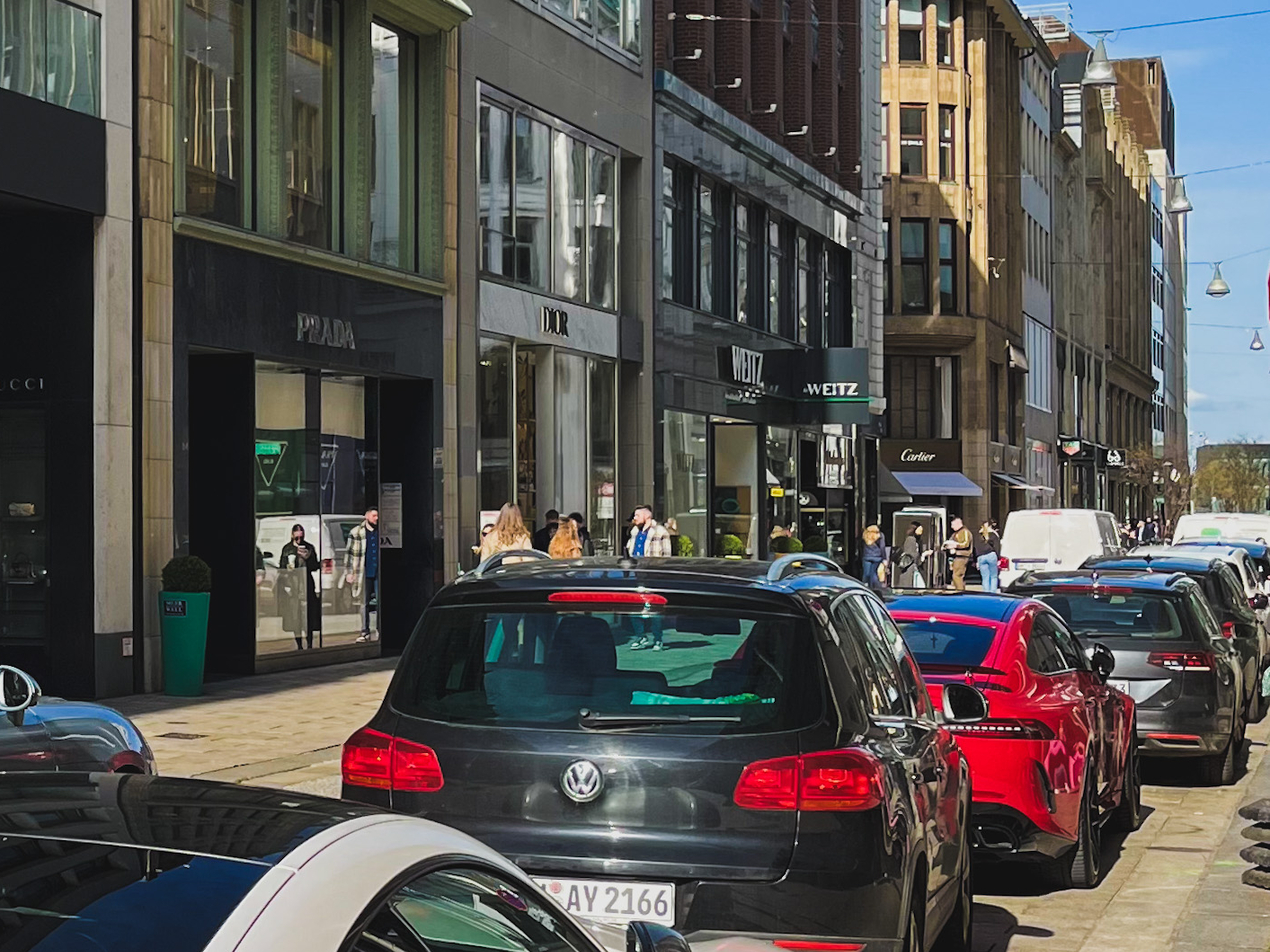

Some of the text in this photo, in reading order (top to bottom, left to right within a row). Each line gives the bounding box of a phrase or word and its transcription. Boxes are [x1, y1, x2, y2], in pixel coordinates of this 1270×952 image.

[296, 312, 356, 350] PRADA
[541, 306, 569, 337] DIOR
[732, 345, 764, 386] WEITZ
[807, 383, 859, 396] WEITZ
[900, 448, 936, 462] Cartier
[567, 884, 668, 916] AY 2166
